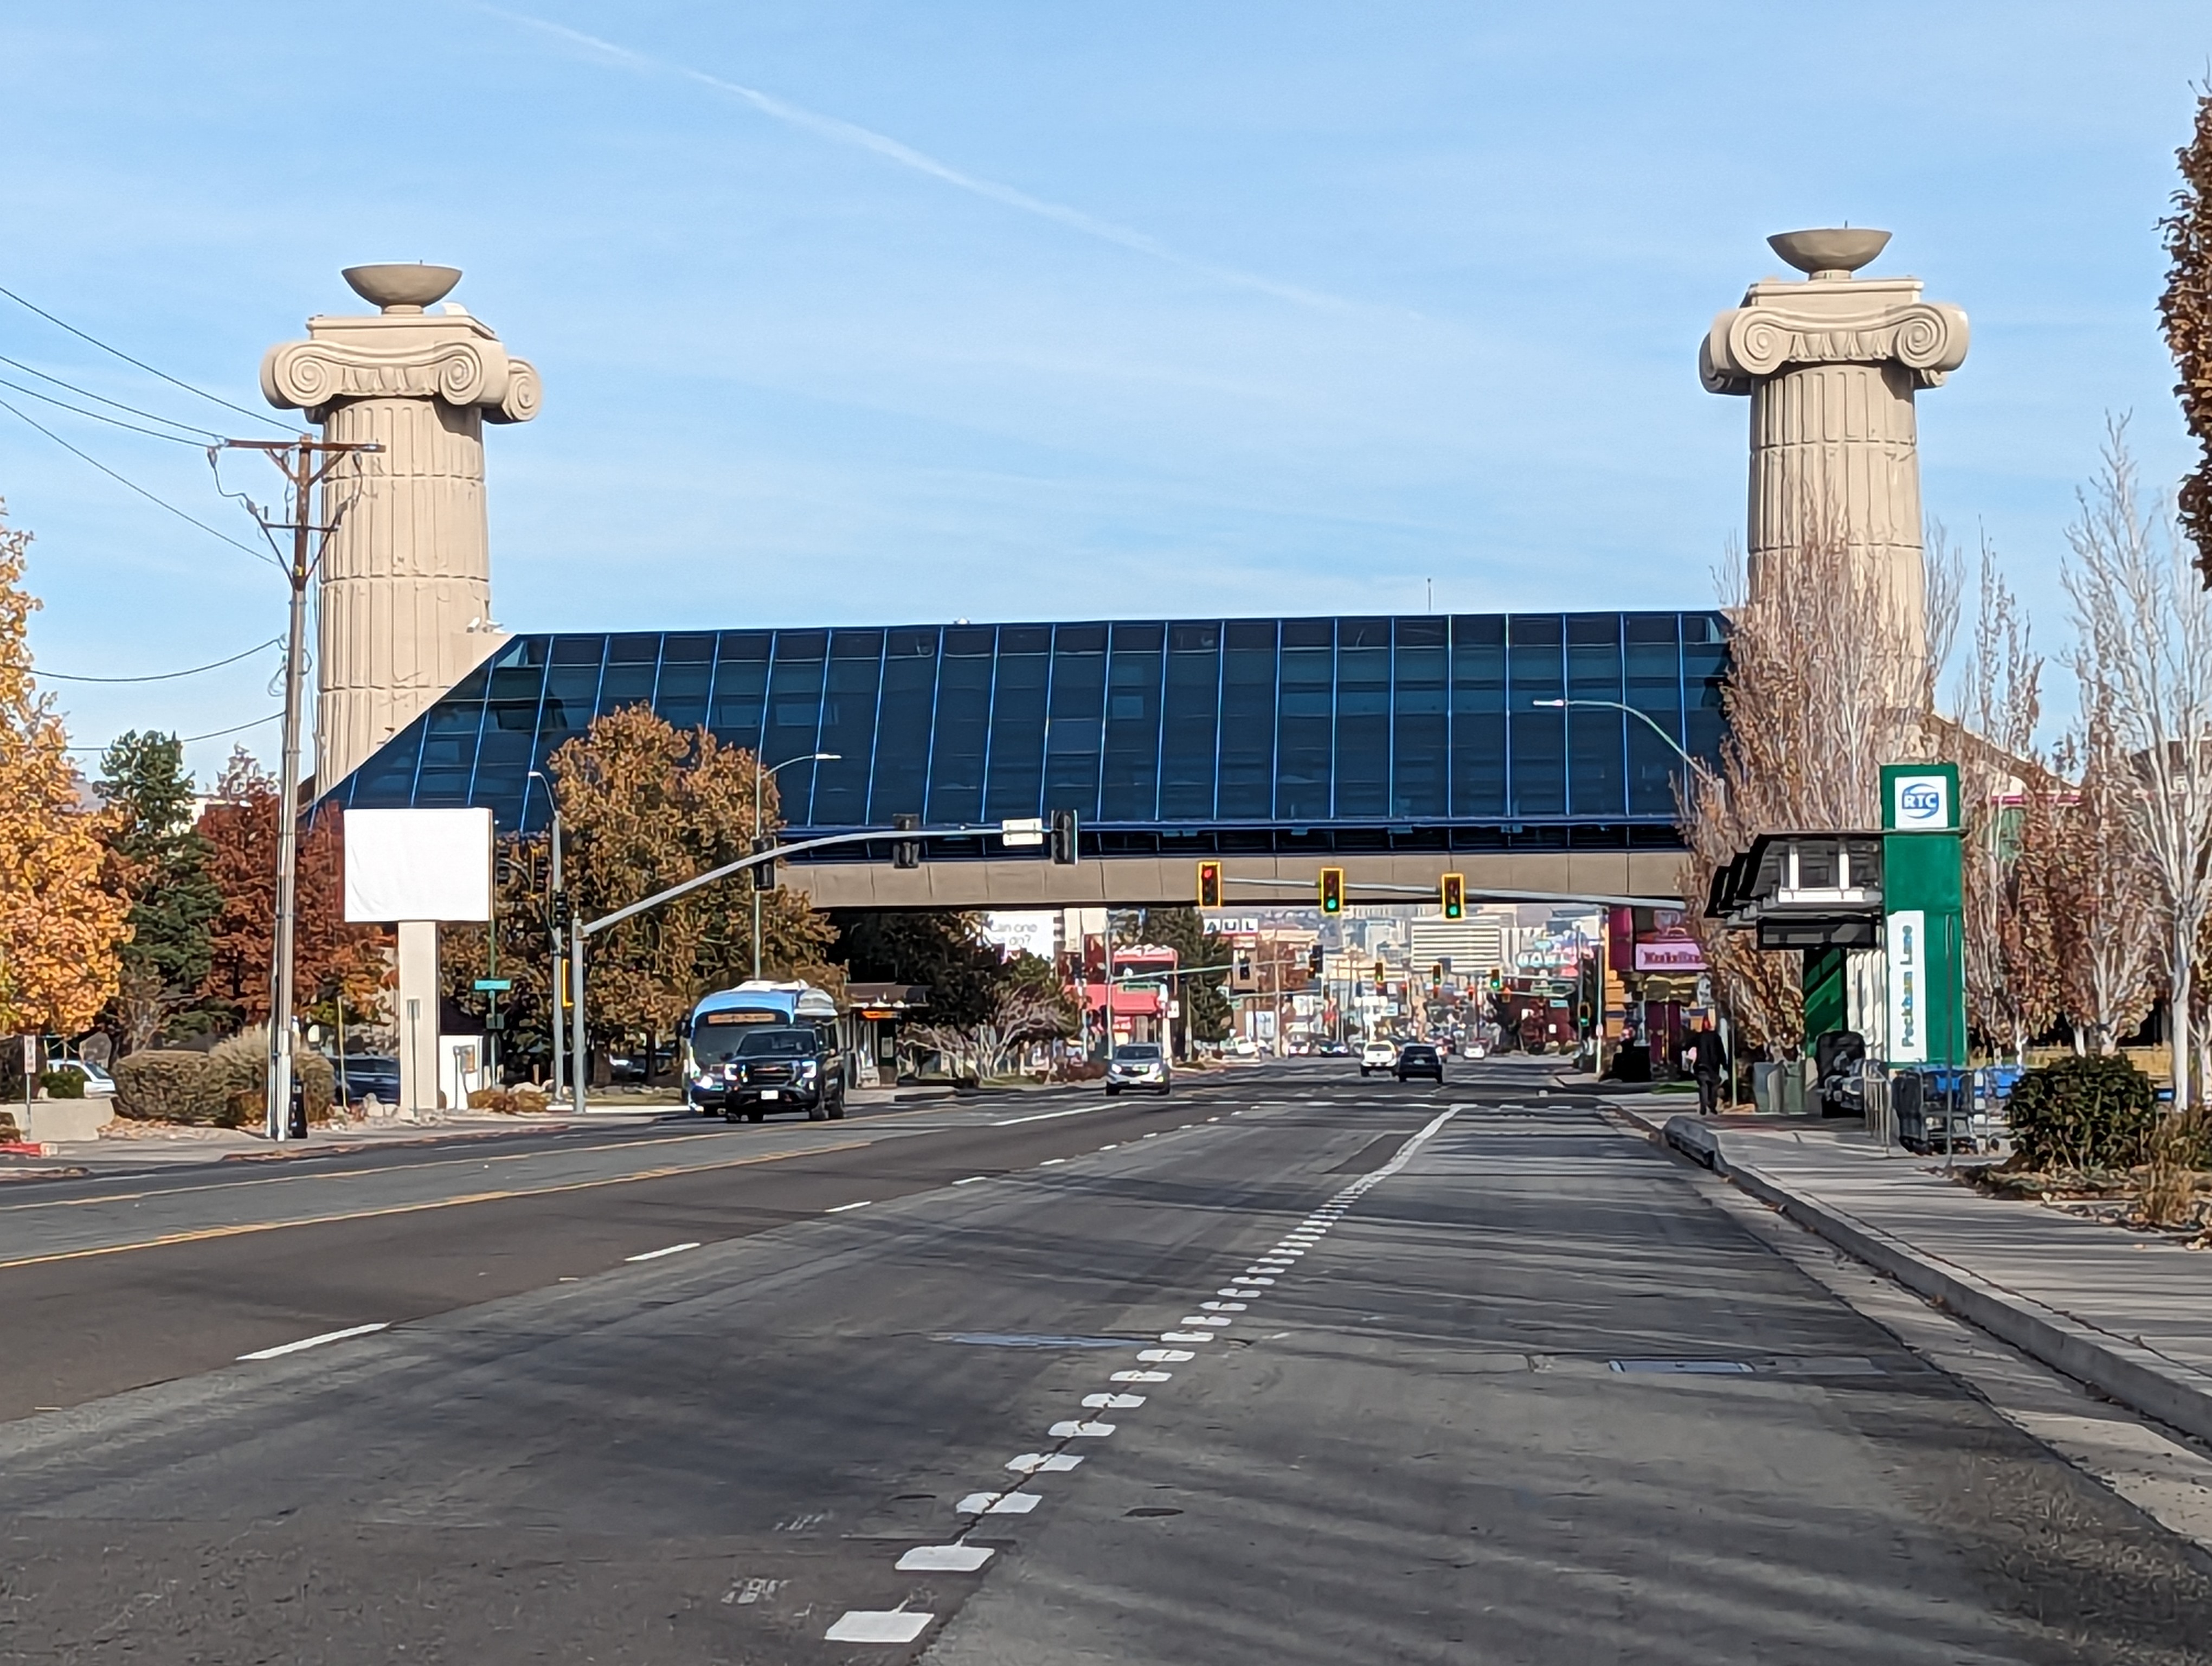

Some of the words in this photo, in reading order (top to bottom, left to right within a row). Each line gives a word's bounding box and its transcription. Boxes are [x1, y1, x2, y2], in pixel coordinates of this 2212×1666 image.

[1904, 793, 1938, 808] RTC
[1014, 924, 1038, 933] one
[1899, 925, 1913, 965] Lane
[1901, 971, 1915, 1047] Peckham
